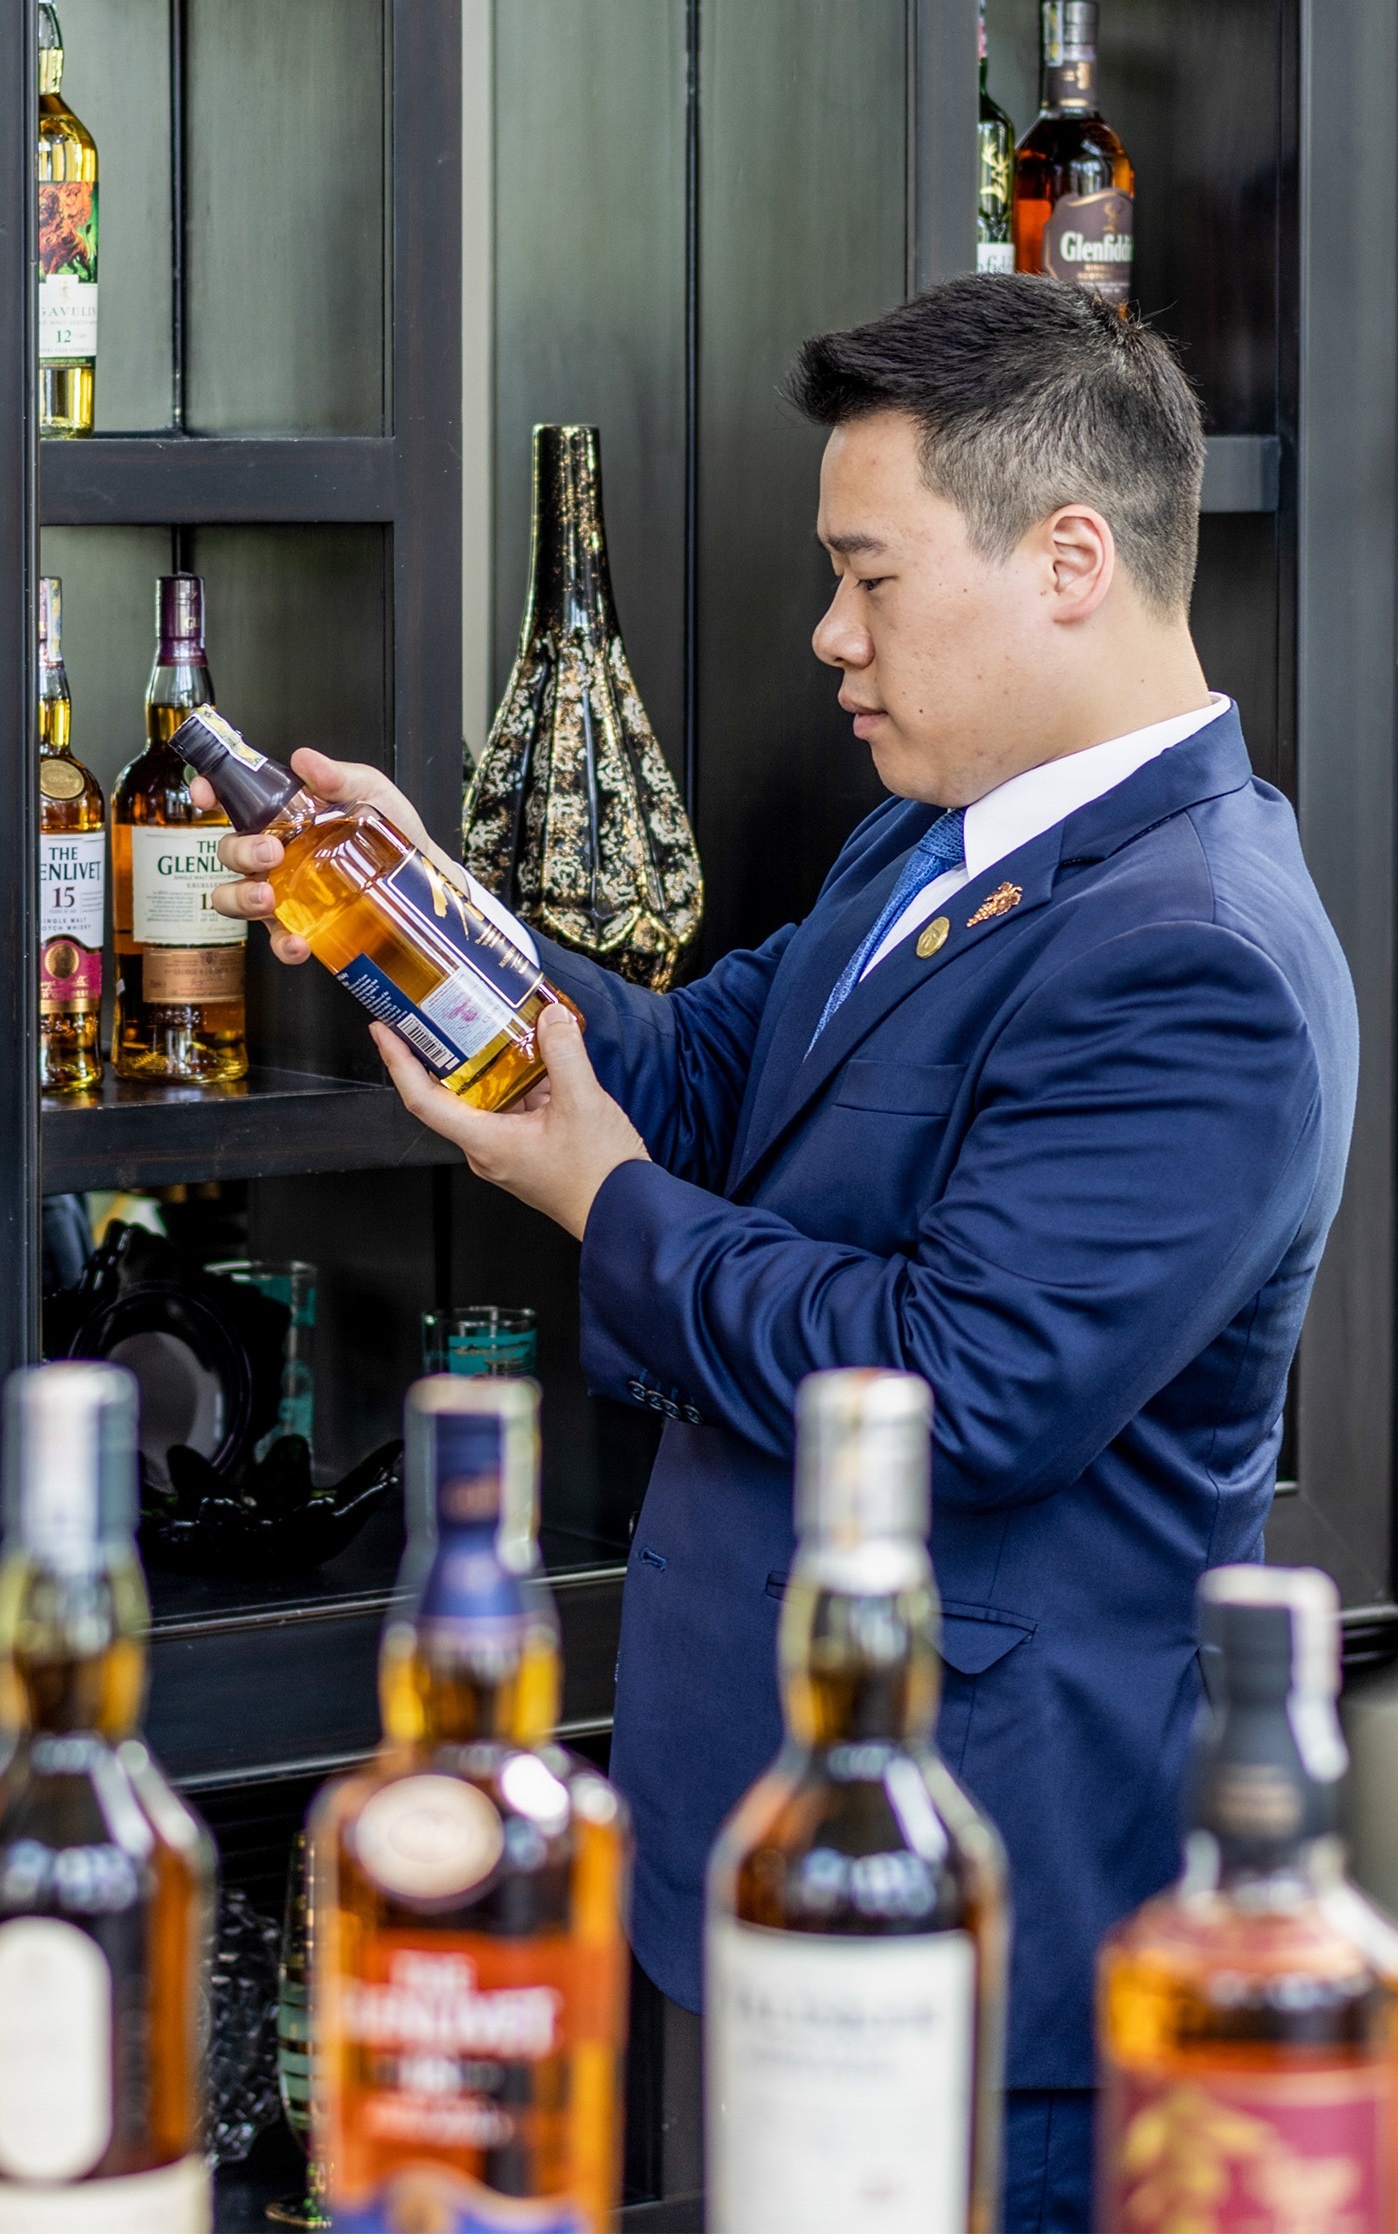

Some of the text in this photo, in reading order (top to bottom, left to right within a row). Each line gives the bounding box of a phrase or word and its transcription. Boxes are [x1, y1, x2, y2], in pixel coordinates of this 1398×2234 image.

[57, 329, 71, 343] 12
[49, 847, 78, 860] THE
[158, 855, 232, 875] GLENLI
[53, 886, 75, 908] 15
